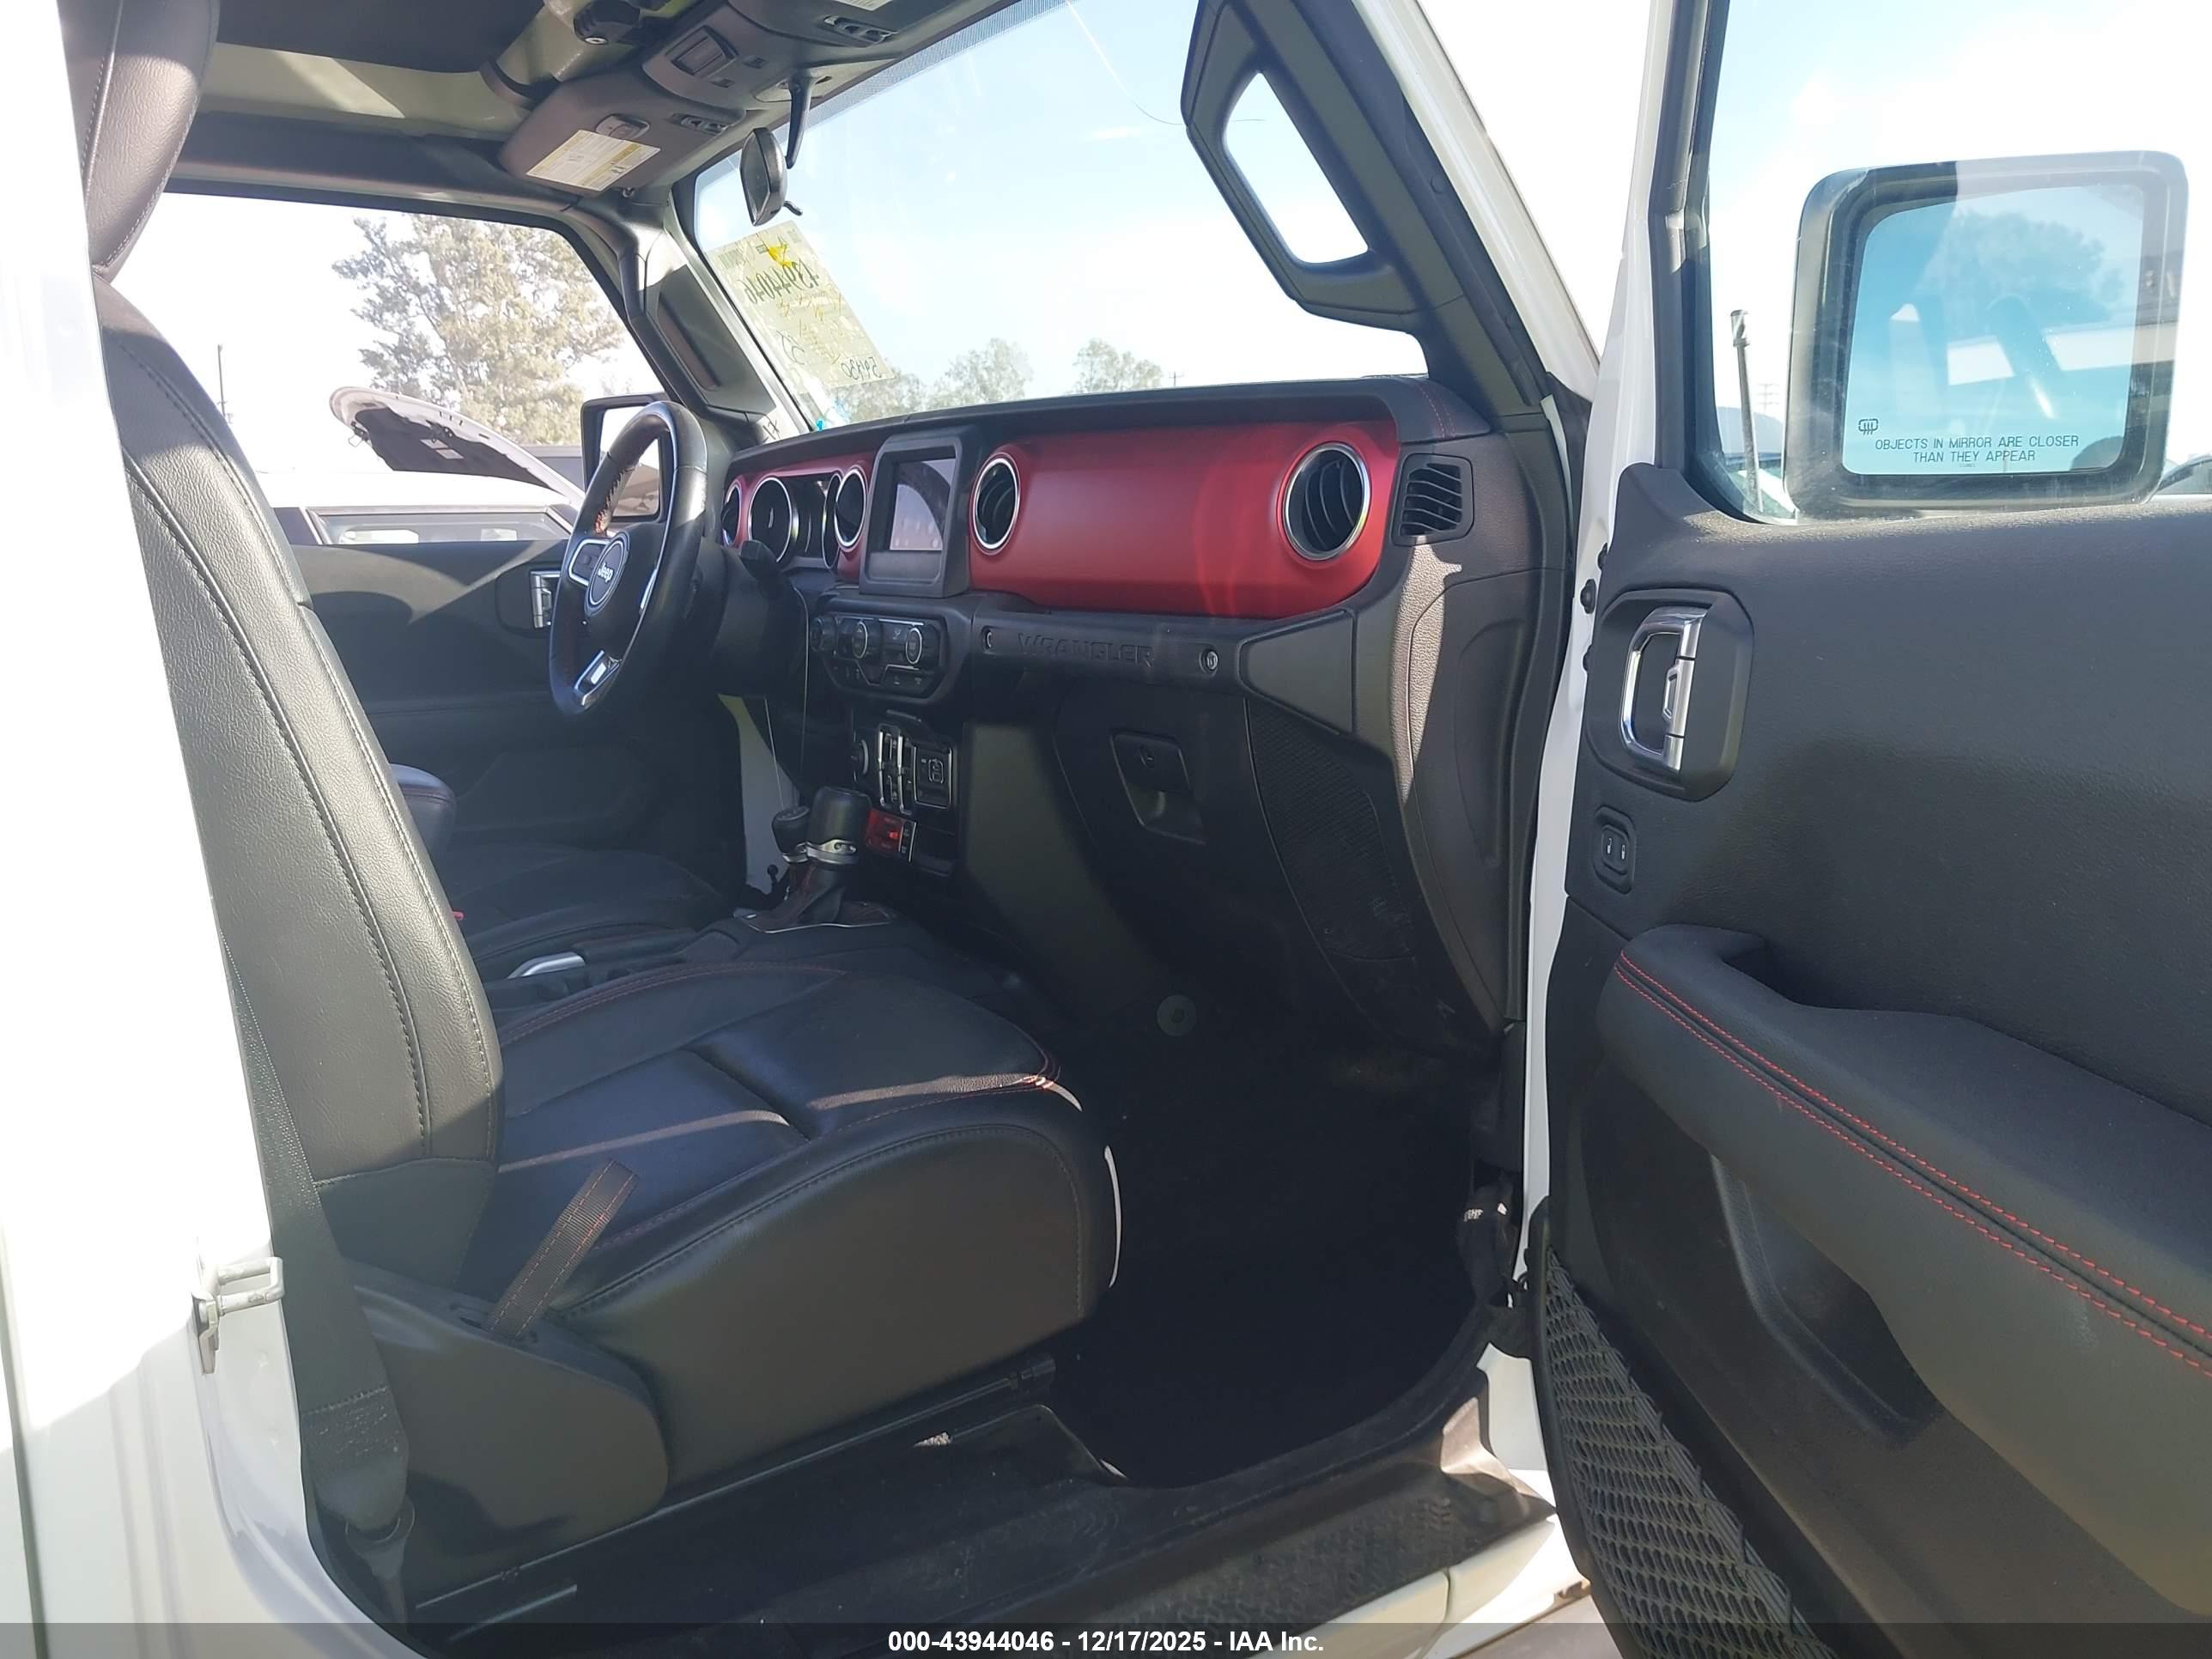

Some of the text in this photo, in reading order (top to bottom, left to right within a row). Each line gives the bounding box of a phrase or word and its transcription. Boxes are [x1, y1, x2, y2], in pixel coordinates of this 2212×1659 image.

[1875, 434, 2079, 450] OBJECTS IN MIRROR ARE CLOSER
[1913, 450, 2035, 463] THAN THEY APPEAR
[598, 562, 614, 583] Jeep
[1017, 632, 1155, 667] WRANGLER
